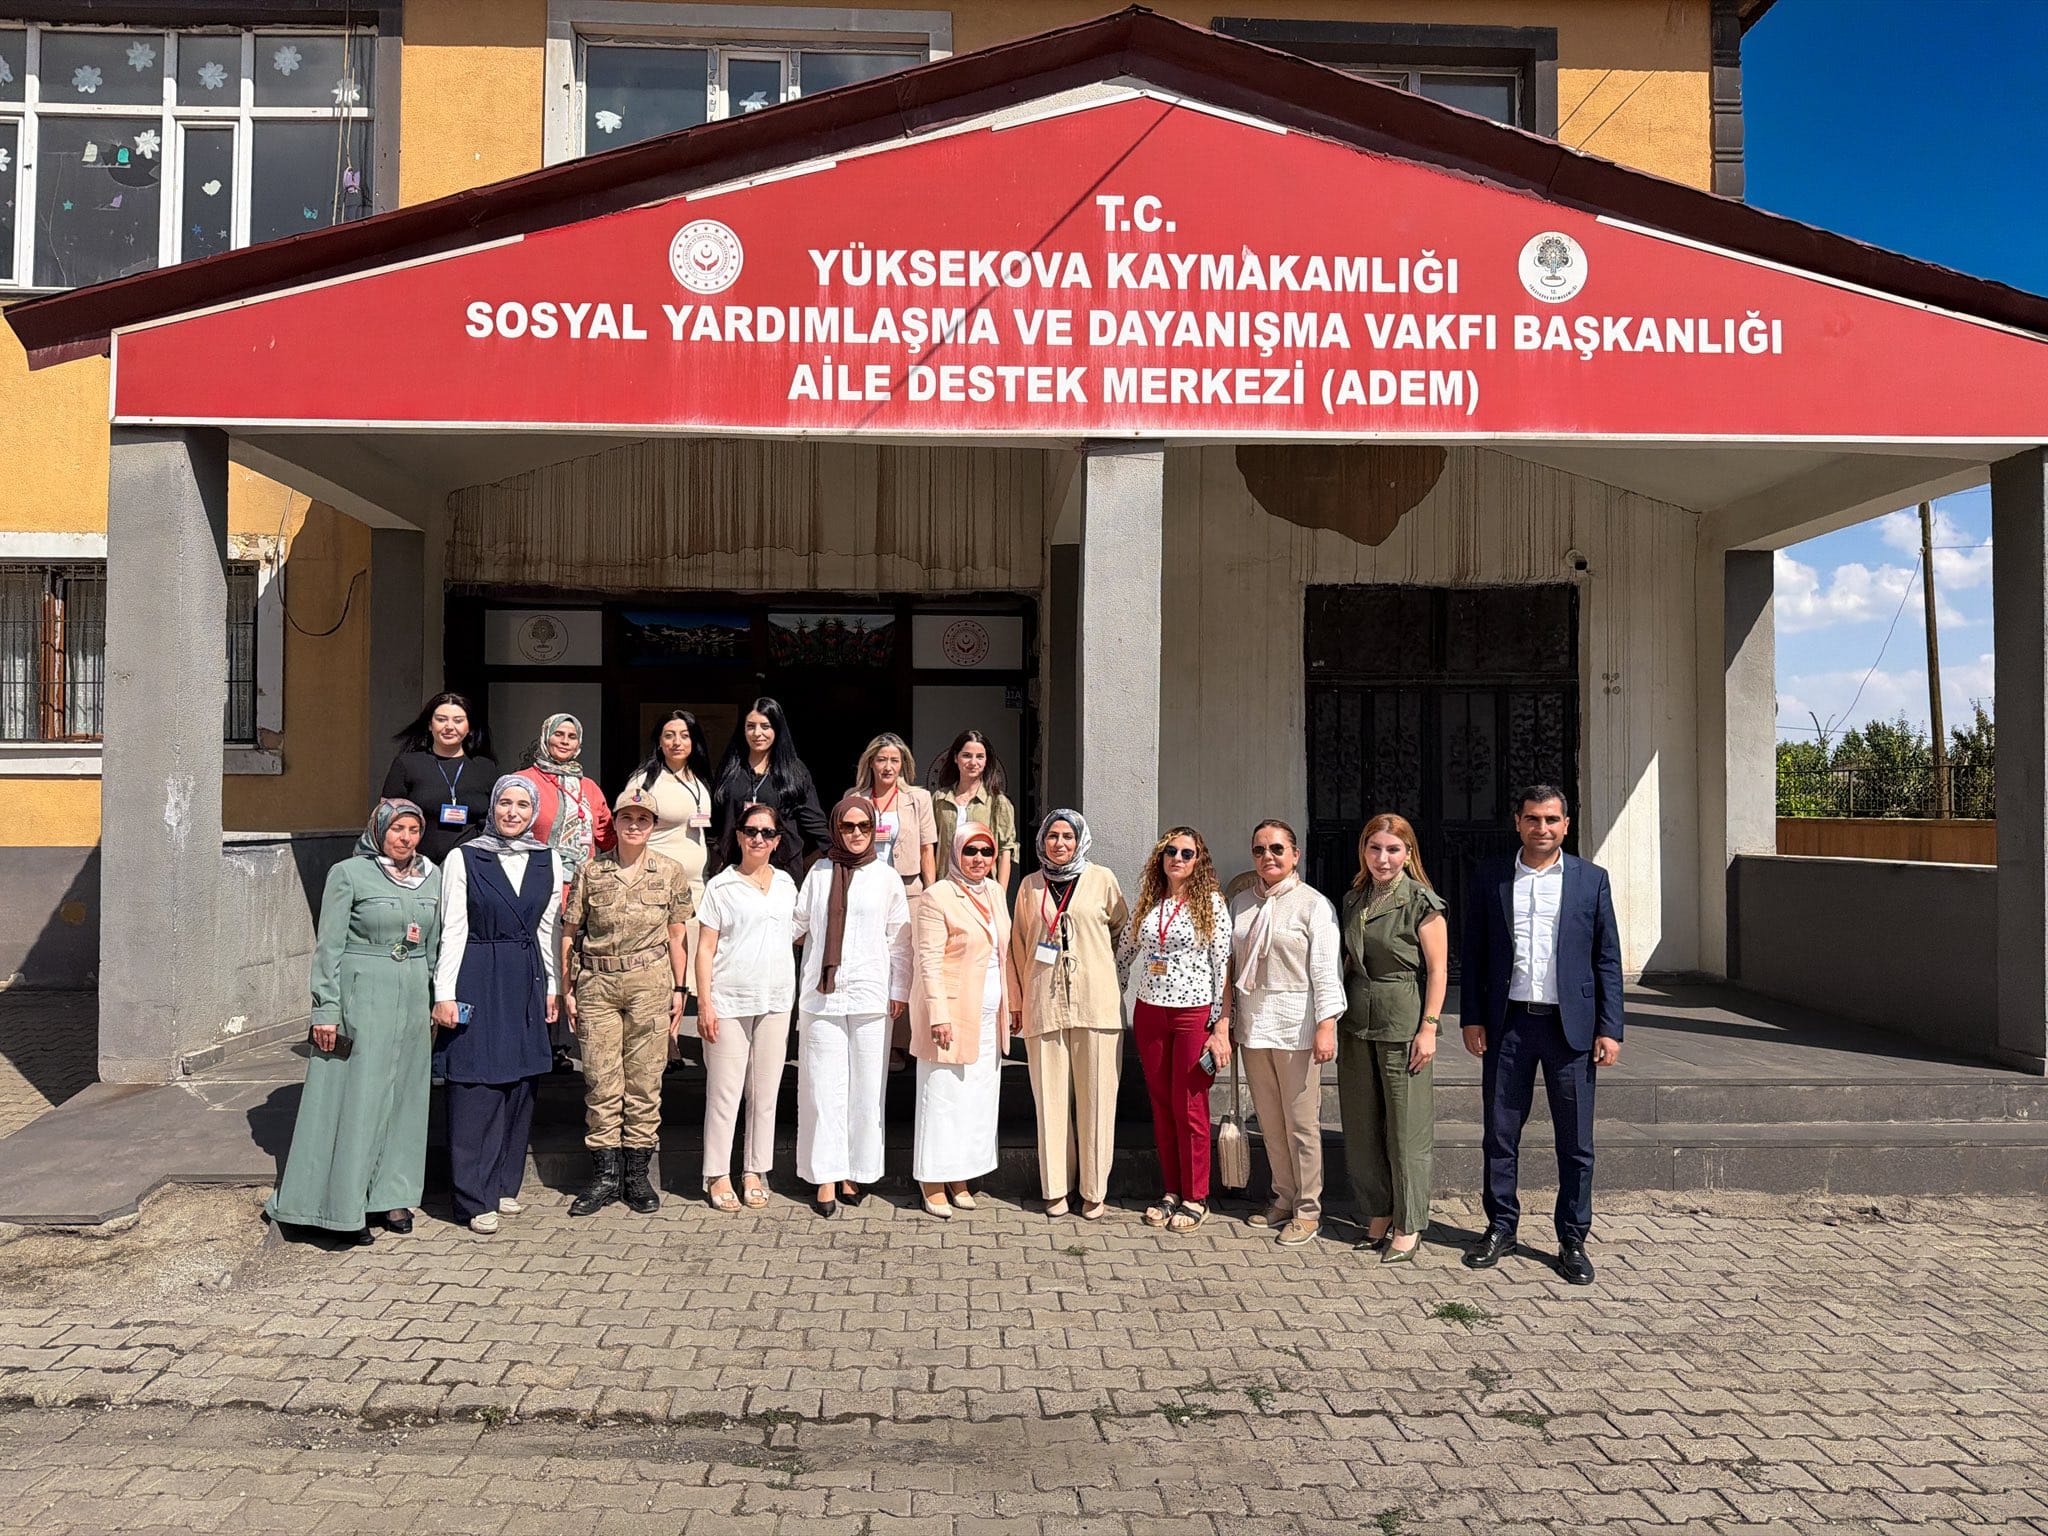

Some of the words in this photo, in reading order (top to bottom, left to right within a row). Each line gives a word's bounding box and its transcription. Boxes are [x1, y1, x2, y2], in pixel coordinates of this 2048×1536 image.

[1096, 195, 1177, 233] T.C.
[808, 242, 1093, 289] YÜKSEKOVA
[1108, 247, 1458, 294] KAYMAKAMLIĞI
[466, 301, 647, 340] SOSYAL
[662, 305, 1000, 354] YARDIMLAŞMA
[1013, 309, 1073, 346] VE
[1090, 310, 1351, 358] DAYANIŞMA
[1364, 313, 1497, 350] VAKFI
[1514, 311, 1783, 361] BAŞKANLIĞI
[788, 355, 891, 401] AİLE
[908, 365, 1088, 404] DESTEK
[1103, 360, 1305, 405] MERKEZİ
[1322, 369, 1479, 415] (ADEM)
